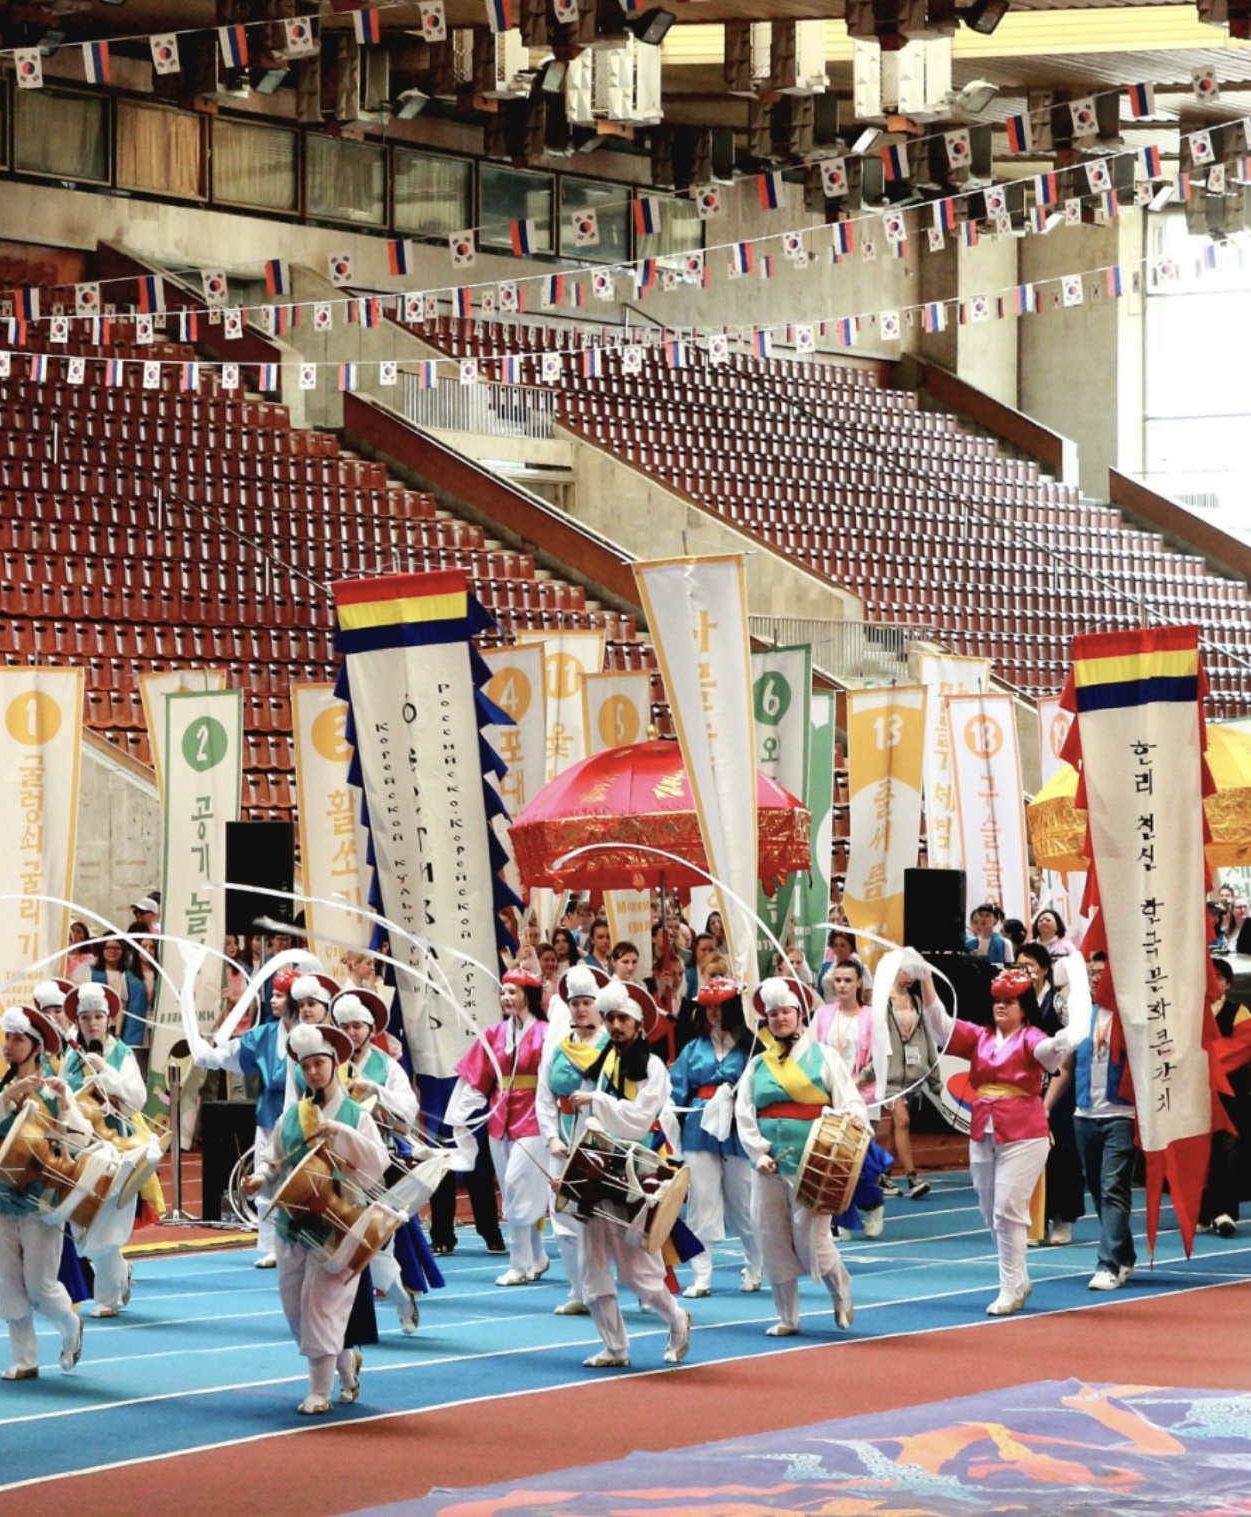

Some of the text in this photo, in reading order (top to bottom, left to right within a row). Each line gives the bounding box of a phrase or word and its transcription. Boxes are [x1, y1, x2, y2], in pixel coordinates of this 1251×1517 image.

[500, 676, 519, 713] 4
[546, 660, 576, 693] 11
[762, 679, 781, 716] 6
[25, 698, 38, 737] 1
[872, 713, 903, 750] 13
[196, 724, 209, 762] 2
